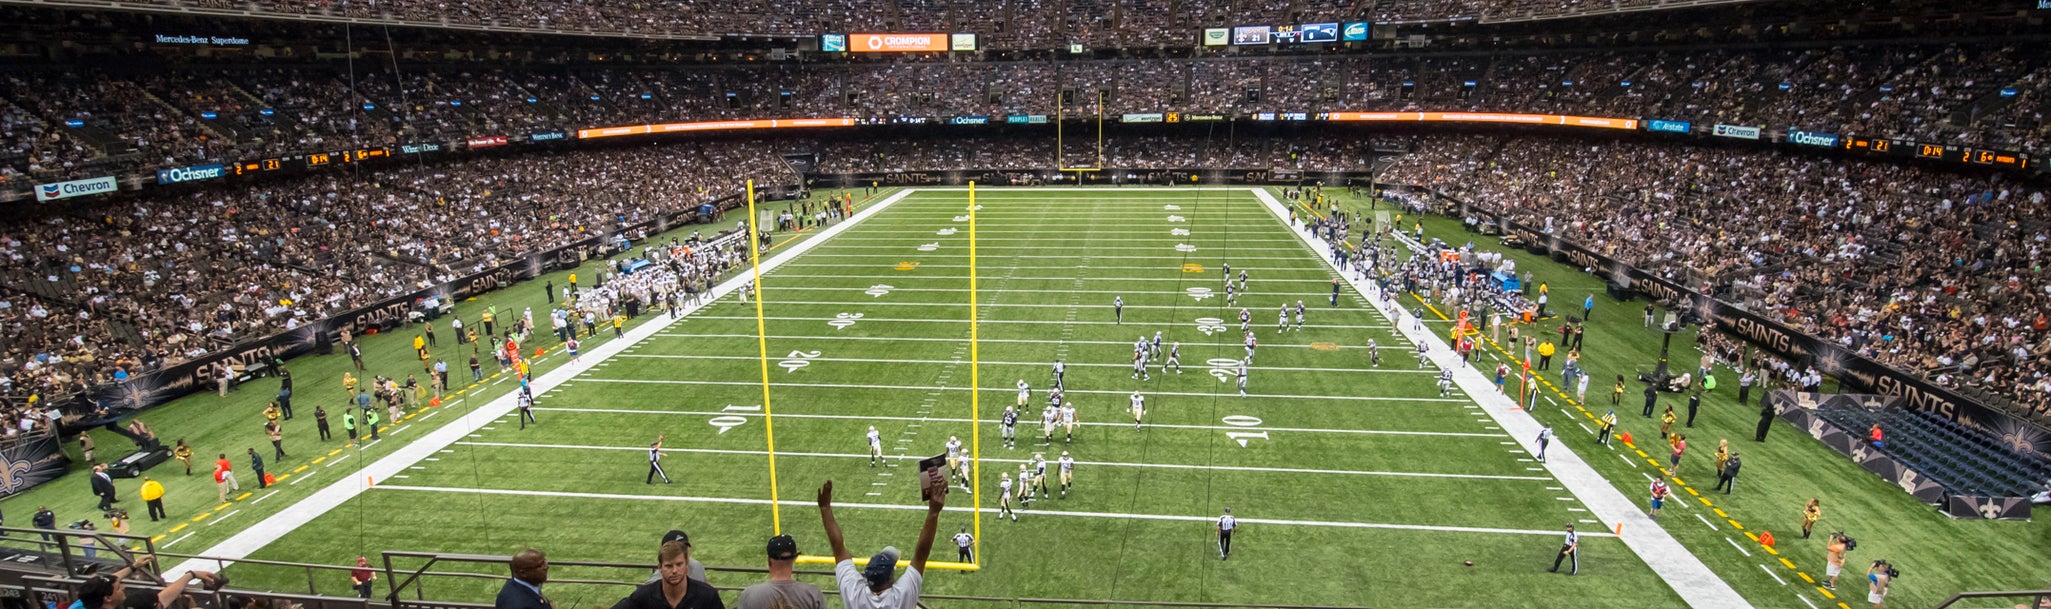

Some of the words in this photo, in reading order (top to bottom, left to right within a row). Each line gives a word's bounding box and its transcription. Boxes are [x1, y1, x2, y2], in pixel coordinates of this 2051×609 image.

[155, 34, 208, 44] Mercedes-Benz
[211, 37, 249, 45] Superdome
[884, 36, 930, 46] CROMPION
[956, 115, 985, 124] Ochsner
[1662, 122, 1685, 131] Allstate
[1727, 126, 1755, 137] Chevron
[1795, 131, 1835, 147] Ochsner
[1876, 141, 1889, 151] 21
[1923, 144, 1943, 156] 0:14
[1962, 151, 1970, 163] 2
[1981, 151, 1987, 163] 6
[268, 160, 279, 169] 21
[170, 166, 220, 182] Ochsner
[886, 173, 928, 183] SAINTS
[63, 179, 111, 195] Chevron
[1570, 249, 1600, 273] SAINTS
[1641, 278, 1679, 301] SAINTS
[1736, 317, 1790, 351] SAINTS
[1876, 375, 1956, 421] SAINTS
[709, 404, 761, 427] 10
